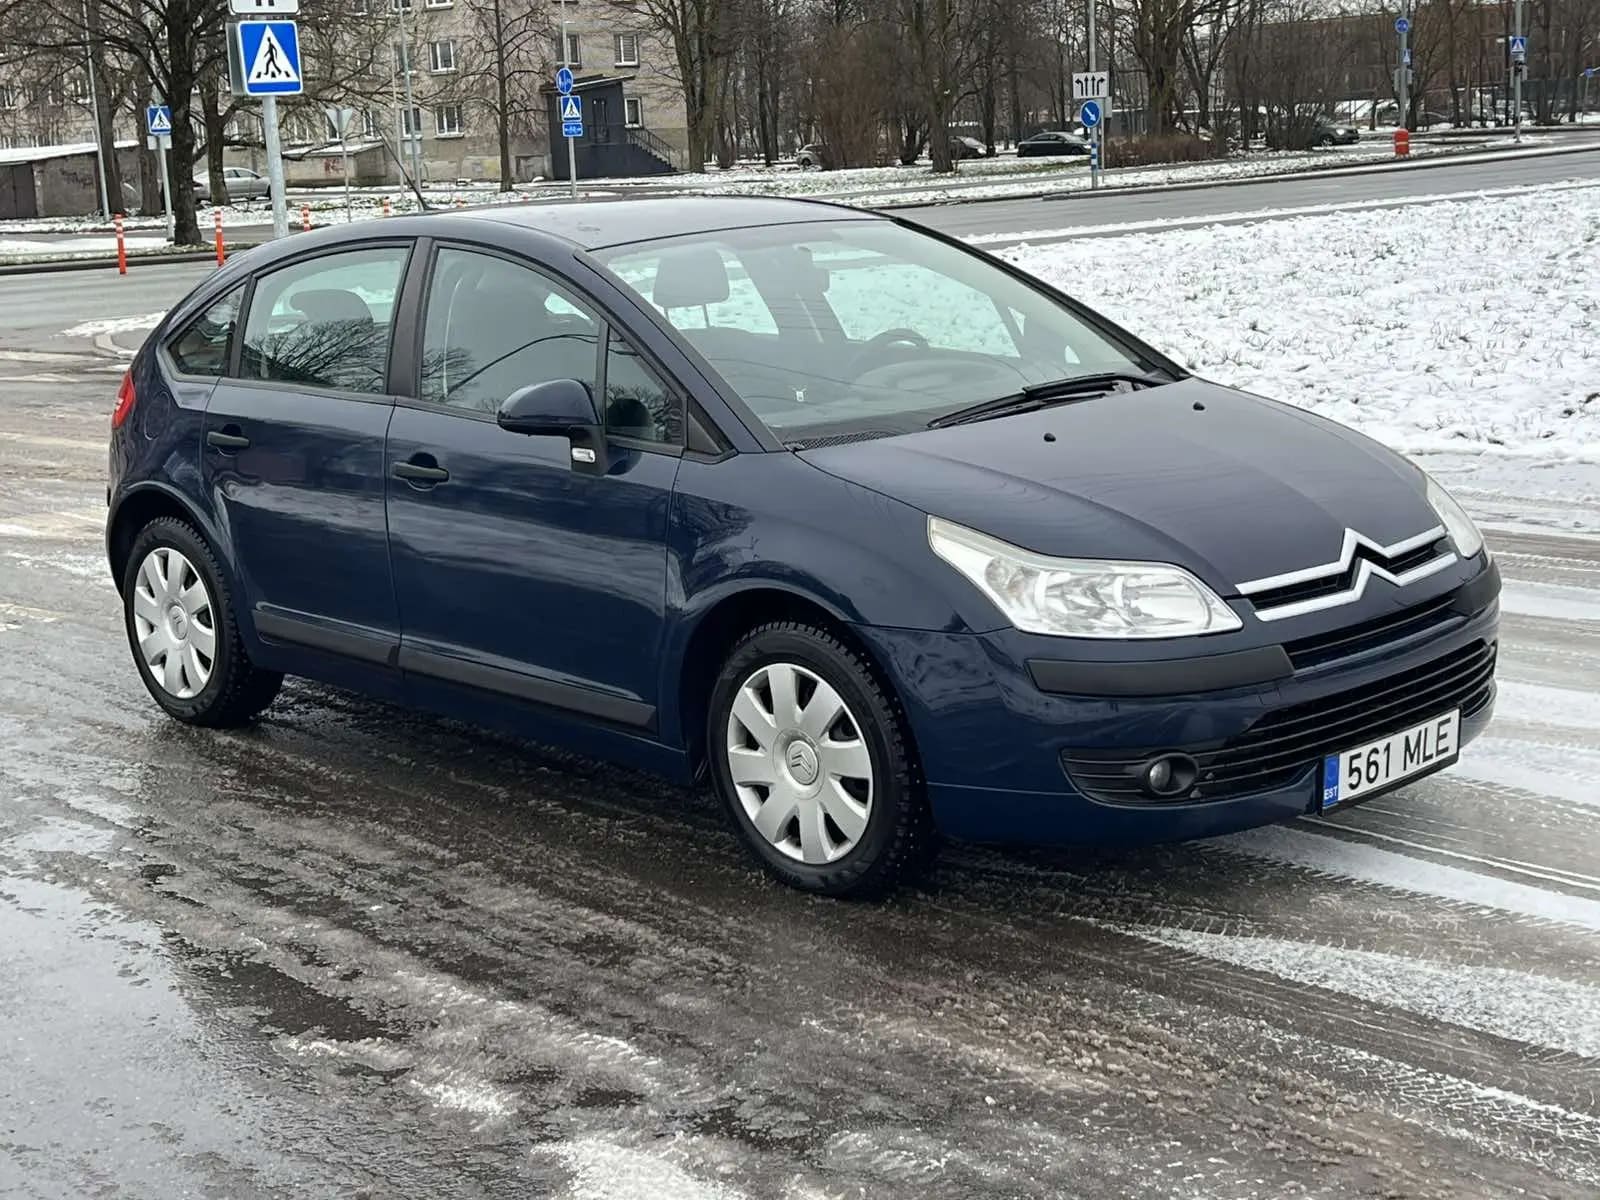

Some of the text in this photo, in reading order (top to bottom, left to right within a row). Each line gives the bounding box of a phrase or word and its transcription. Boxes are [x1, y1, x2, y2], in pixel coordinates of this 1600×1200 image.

[1348, 718, 1452, 790] 561 MLE
[1324, 785, 1338, 800] EST
